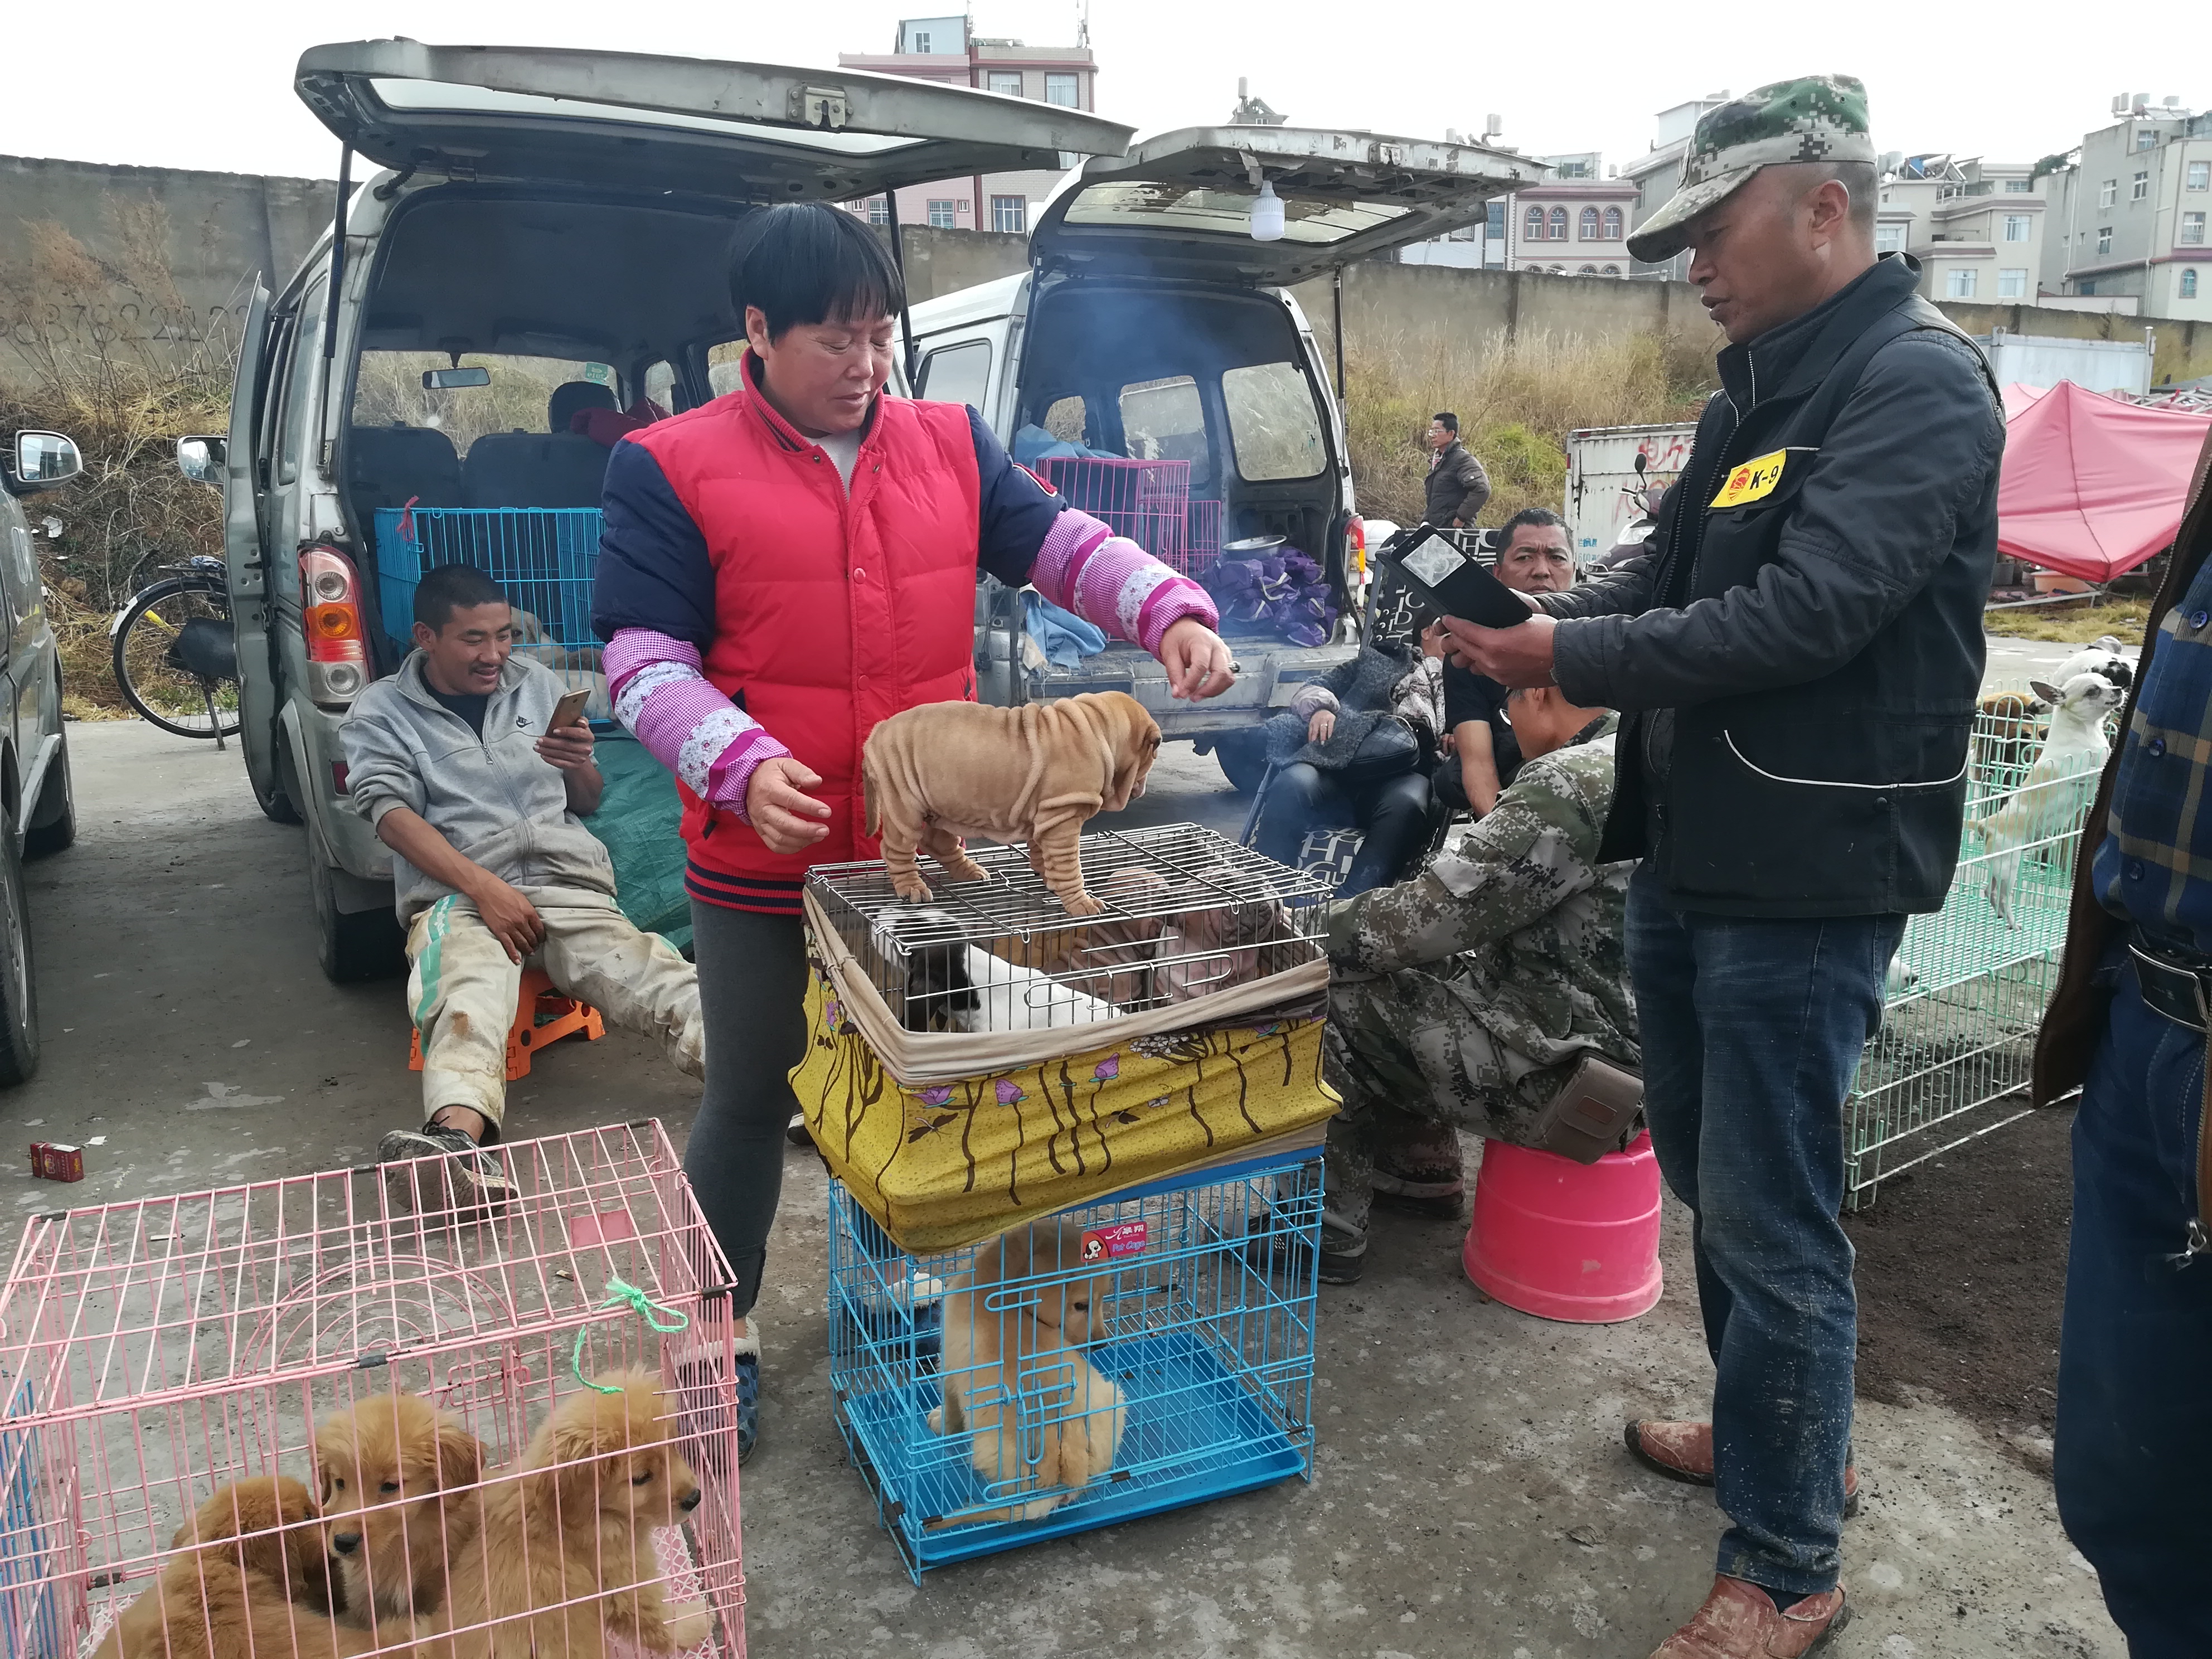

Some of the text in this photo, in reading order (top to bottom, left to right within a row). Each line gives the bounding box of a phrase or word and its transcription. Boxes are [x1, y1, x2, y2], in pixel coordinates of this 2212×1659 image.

[1750, 465, 1779, 490] K-9
[1112, 1240, 1146, 1253] Pet Cage
